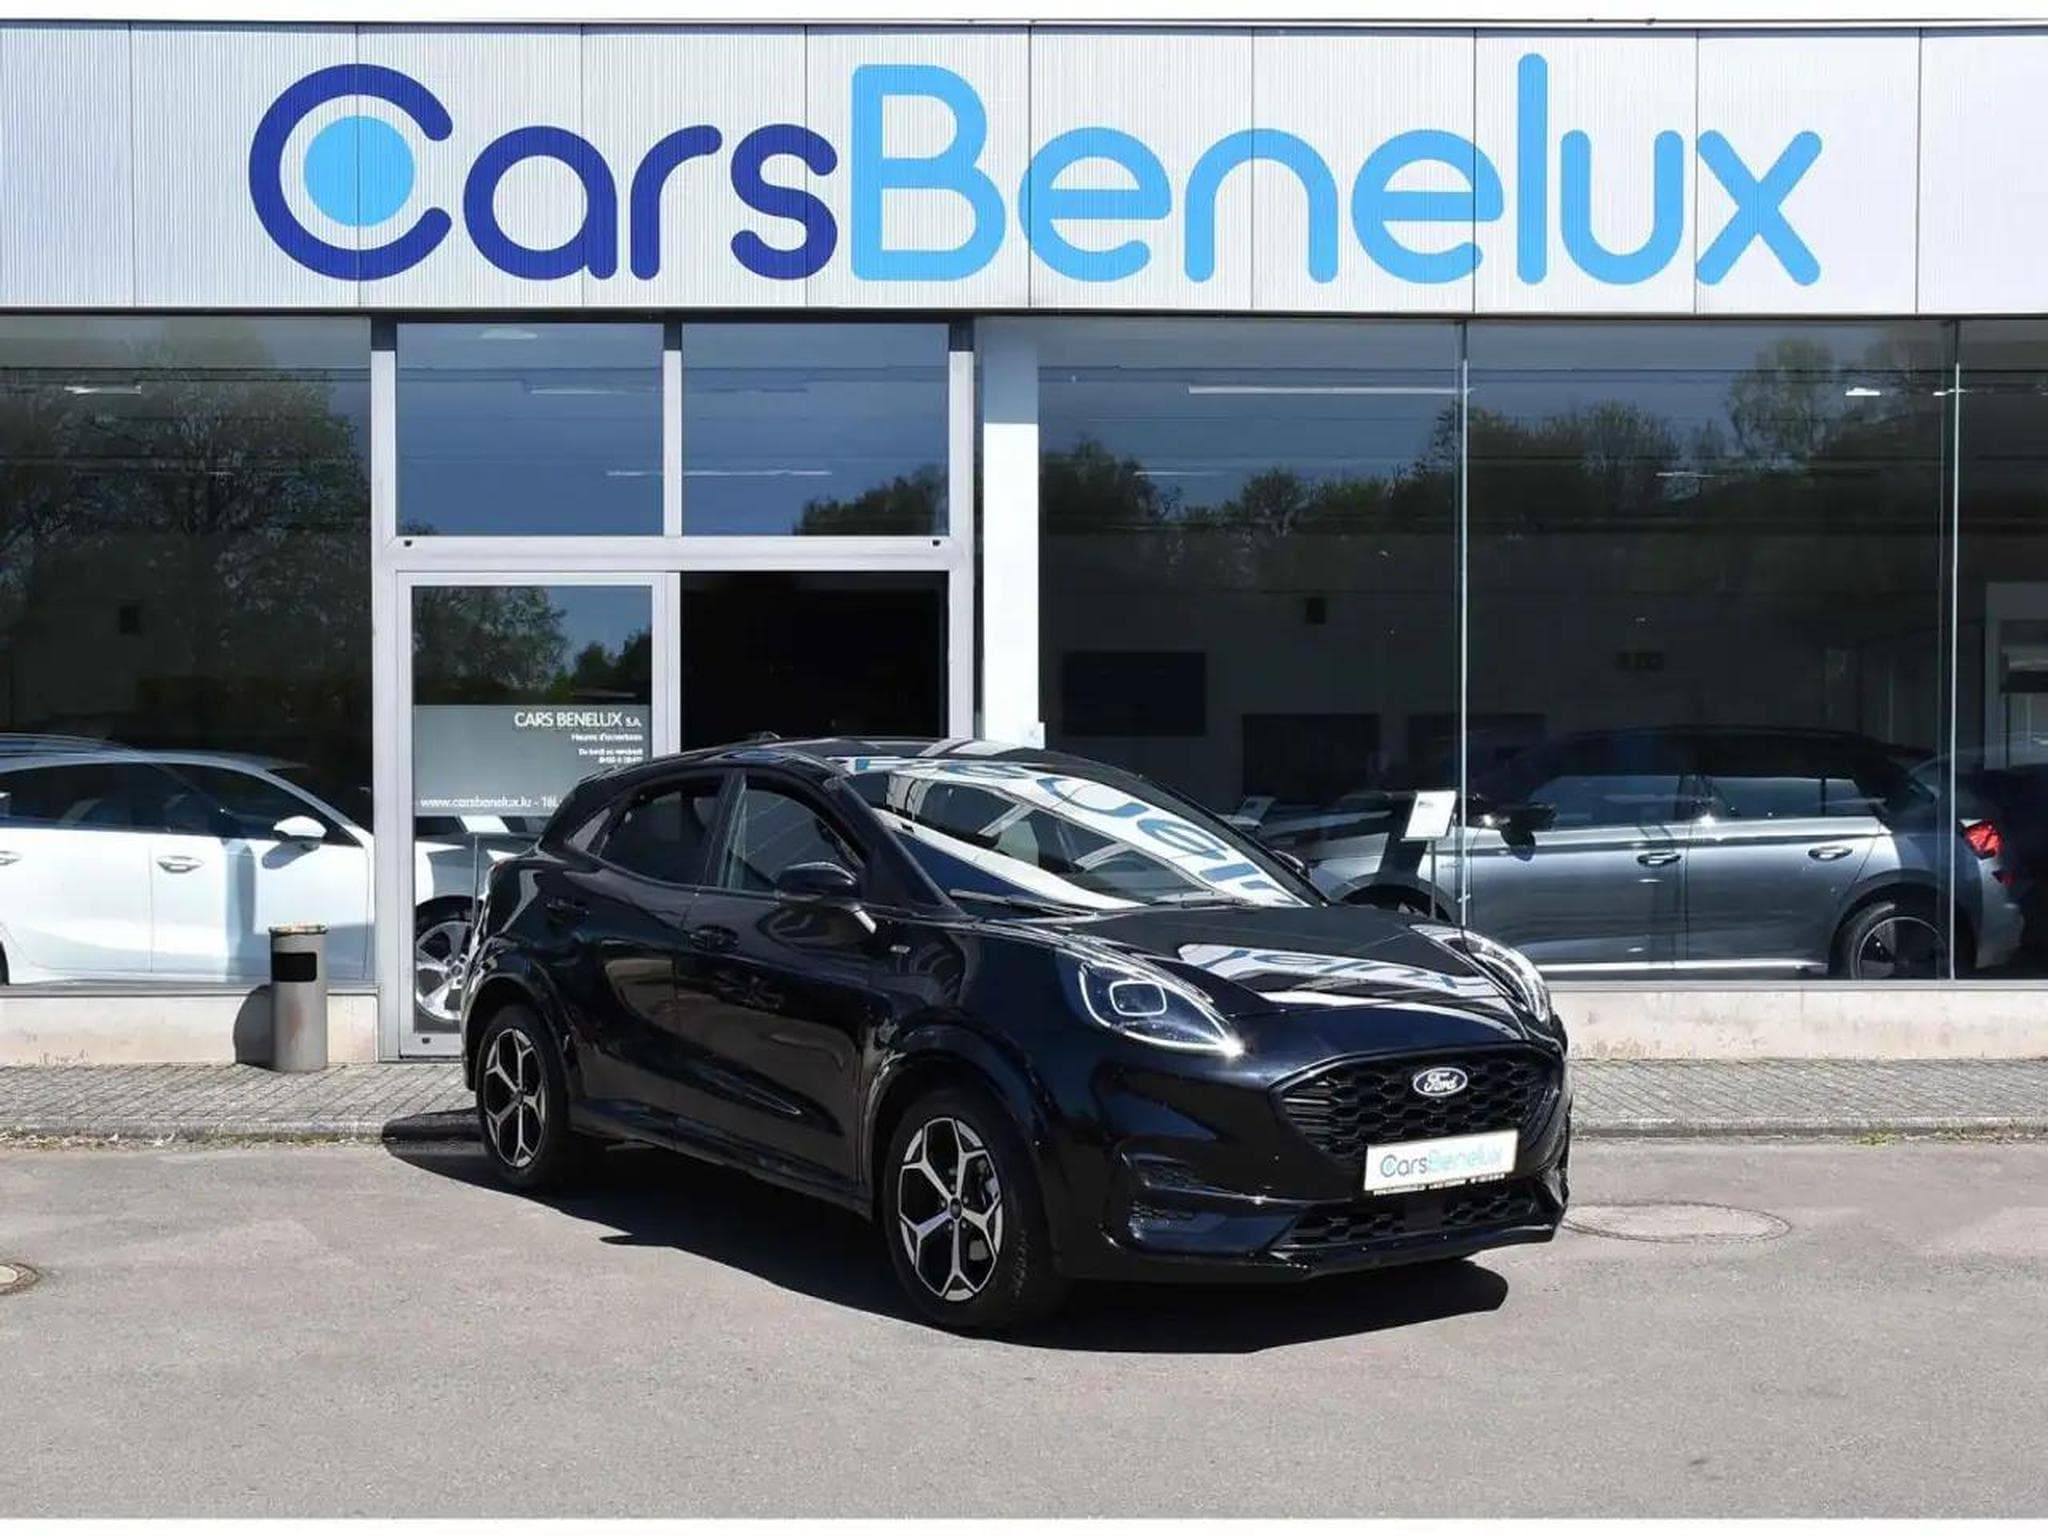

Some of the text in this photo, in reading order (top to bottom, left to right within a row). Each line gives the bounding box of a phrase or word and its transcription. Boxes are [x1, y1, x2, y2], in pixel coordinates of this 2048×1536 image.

[248, 54, 1822, 285] CarsBenelux
[514, 711, 554, 728] CARS
[556, 711, 623, 728] BENELUX
[420, 794, 532, 808] www.carsbenelux.lu
[1424, 1072, 1458, 1092] Ford
